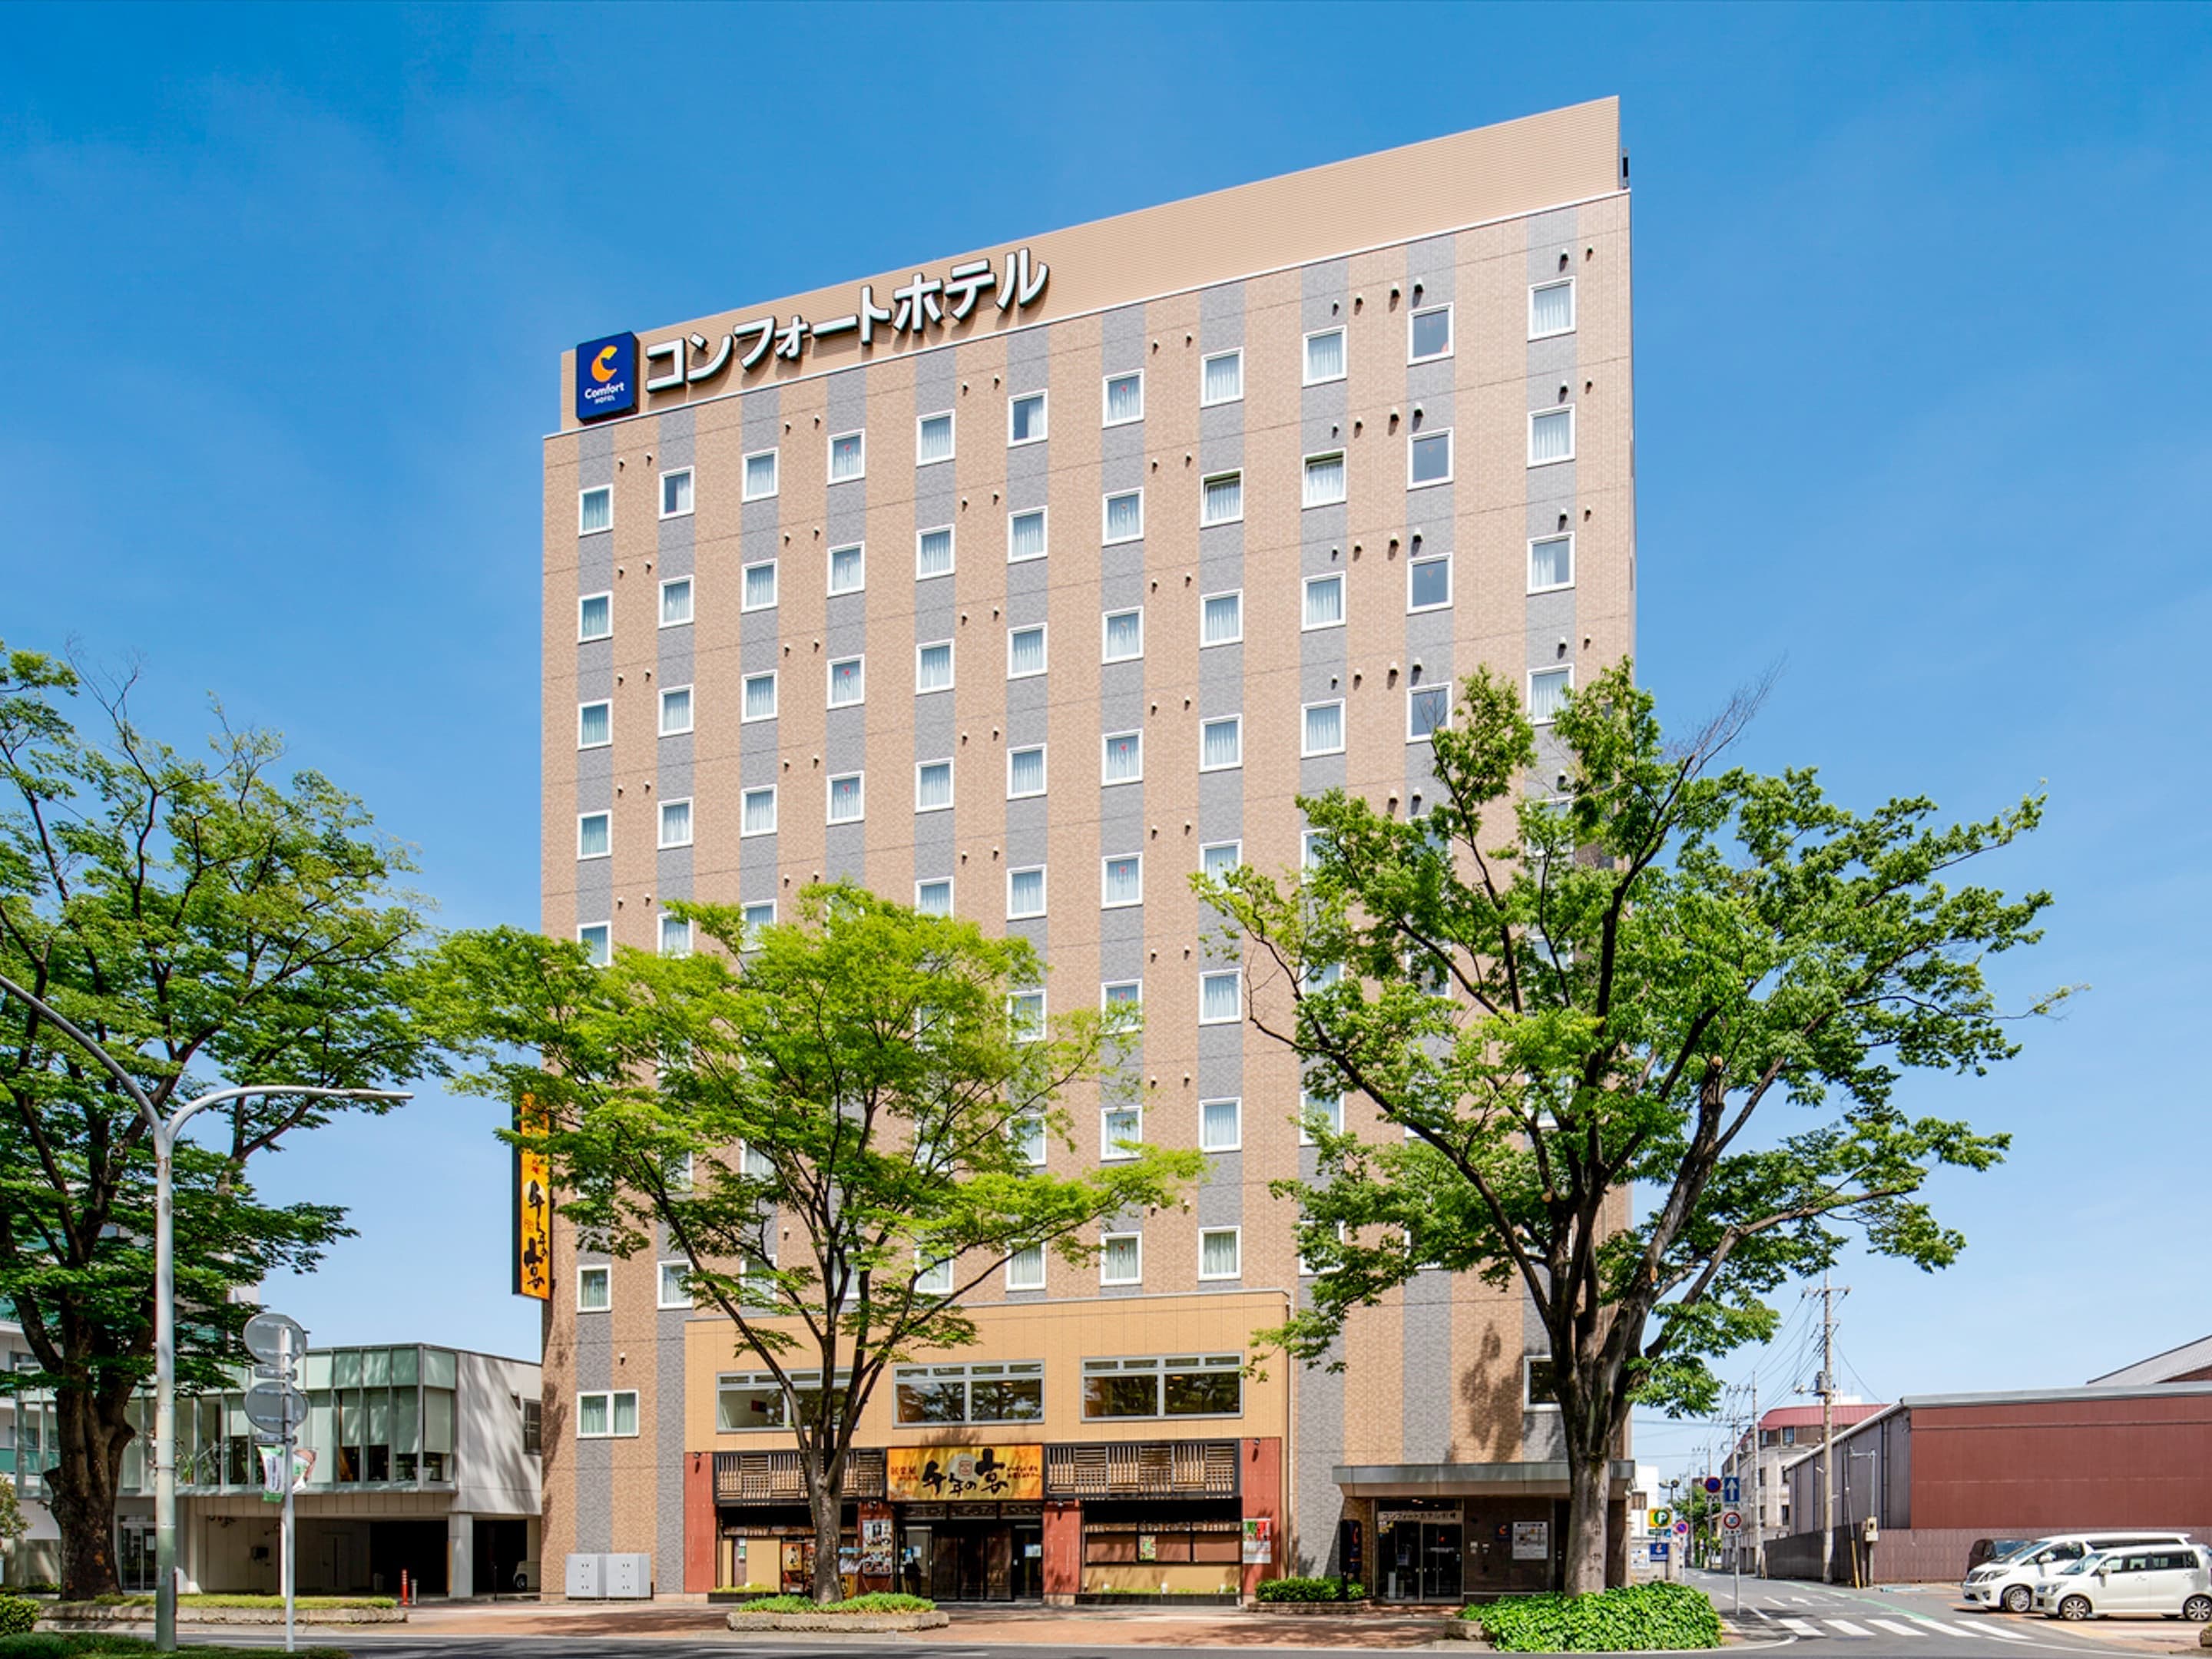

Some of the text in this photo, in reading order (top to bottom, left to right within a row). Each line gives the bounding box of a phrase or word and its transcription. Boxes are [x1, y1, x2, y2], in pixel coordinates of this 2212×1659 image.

[646, 247, 1050, 393] コンフォートホテル
[584, 382, 625, 399] Comfort
[922, 1448, 1009, 1499] 千年の宴
[1657, 1511, 1668, 1525] P
